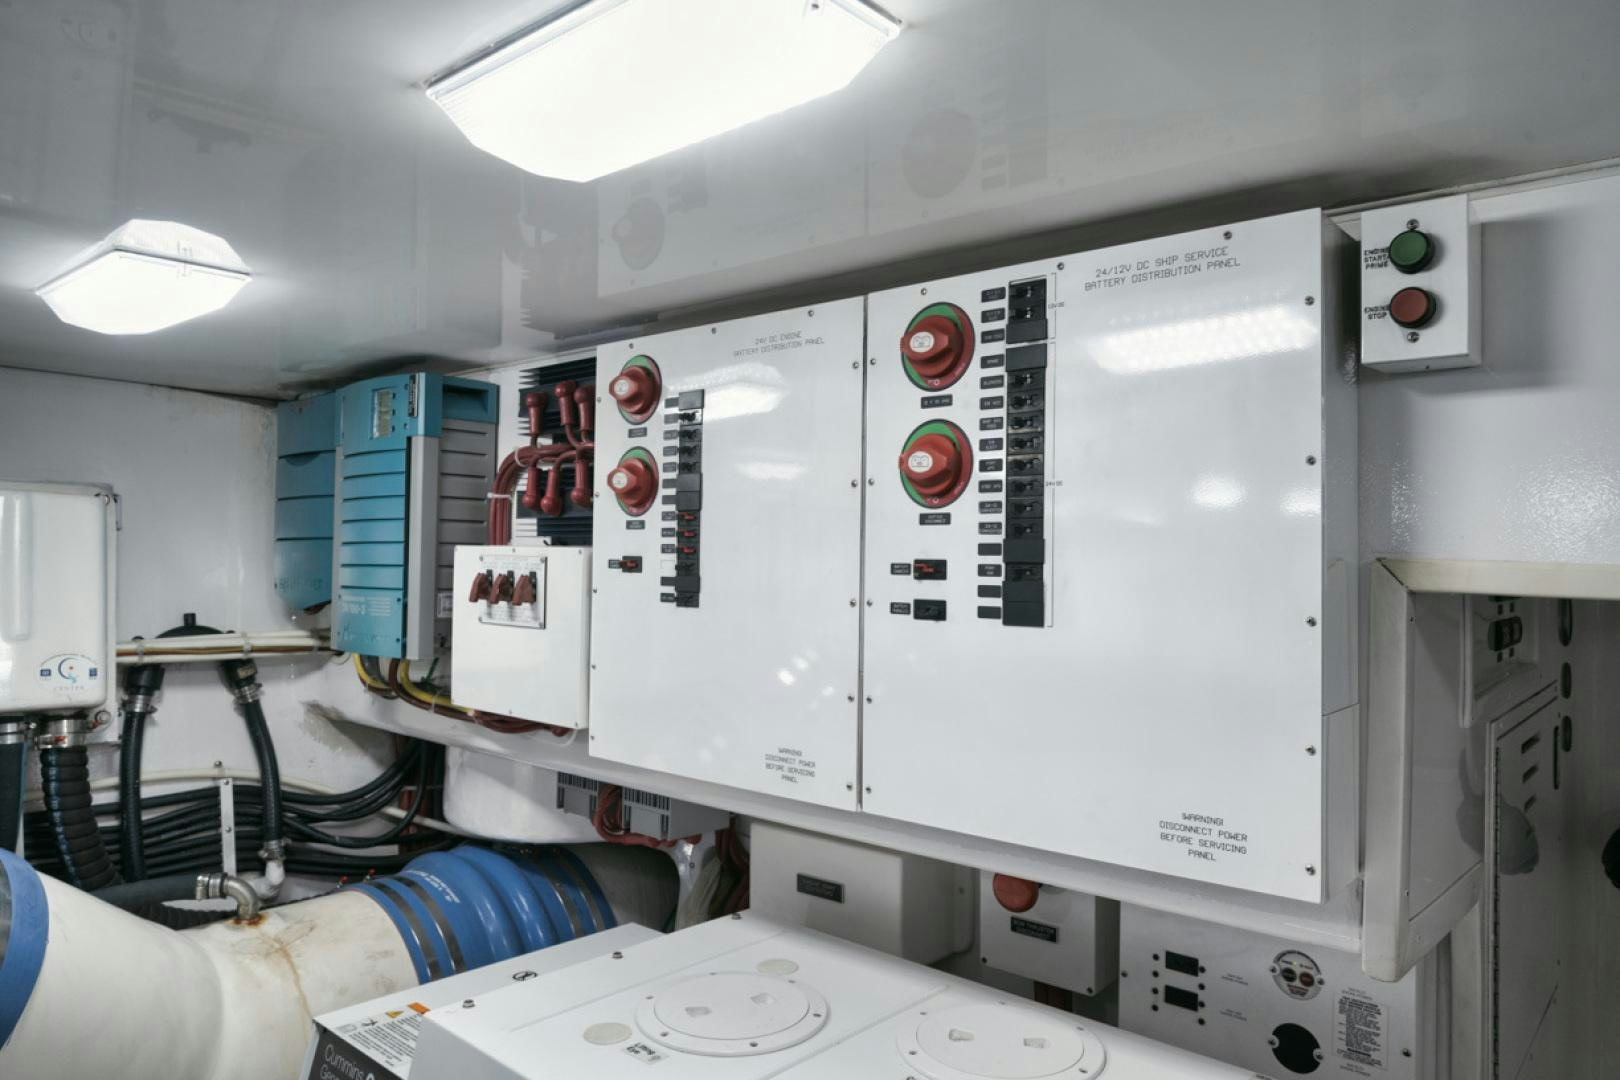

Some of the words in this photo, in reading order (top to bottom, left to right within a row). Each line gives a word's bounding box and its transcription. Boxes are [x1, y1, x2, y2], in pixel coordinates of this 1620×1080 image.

[1096, 263, 1132, 278] 24/12V
[1137, 260, 1149, 271] DC
[1155, 254, 1178, 267] SHIP
[1184, 246, 1229, 262] SERVICE
[1365, 261, 1388, 269] PRIME
[1085, 276, 1126, 291] BATTERY
[1132, 264, 1201, 284] DISTRIBUTION
[1206, 257, 1241, 270] PANEL
[1367, 312, 1387, 320] STOP
[1159, 820, 1213, 836] DISCONNECT
[1218, 829, 1248, 842] POWER
[1160, 832, 1193, 845] BEFORE
[1198, 838, 1248, 855] SERVICING
[1188, 849, 1216, 861] PANEL
[324, 1044, 365, 1080] Cummins
